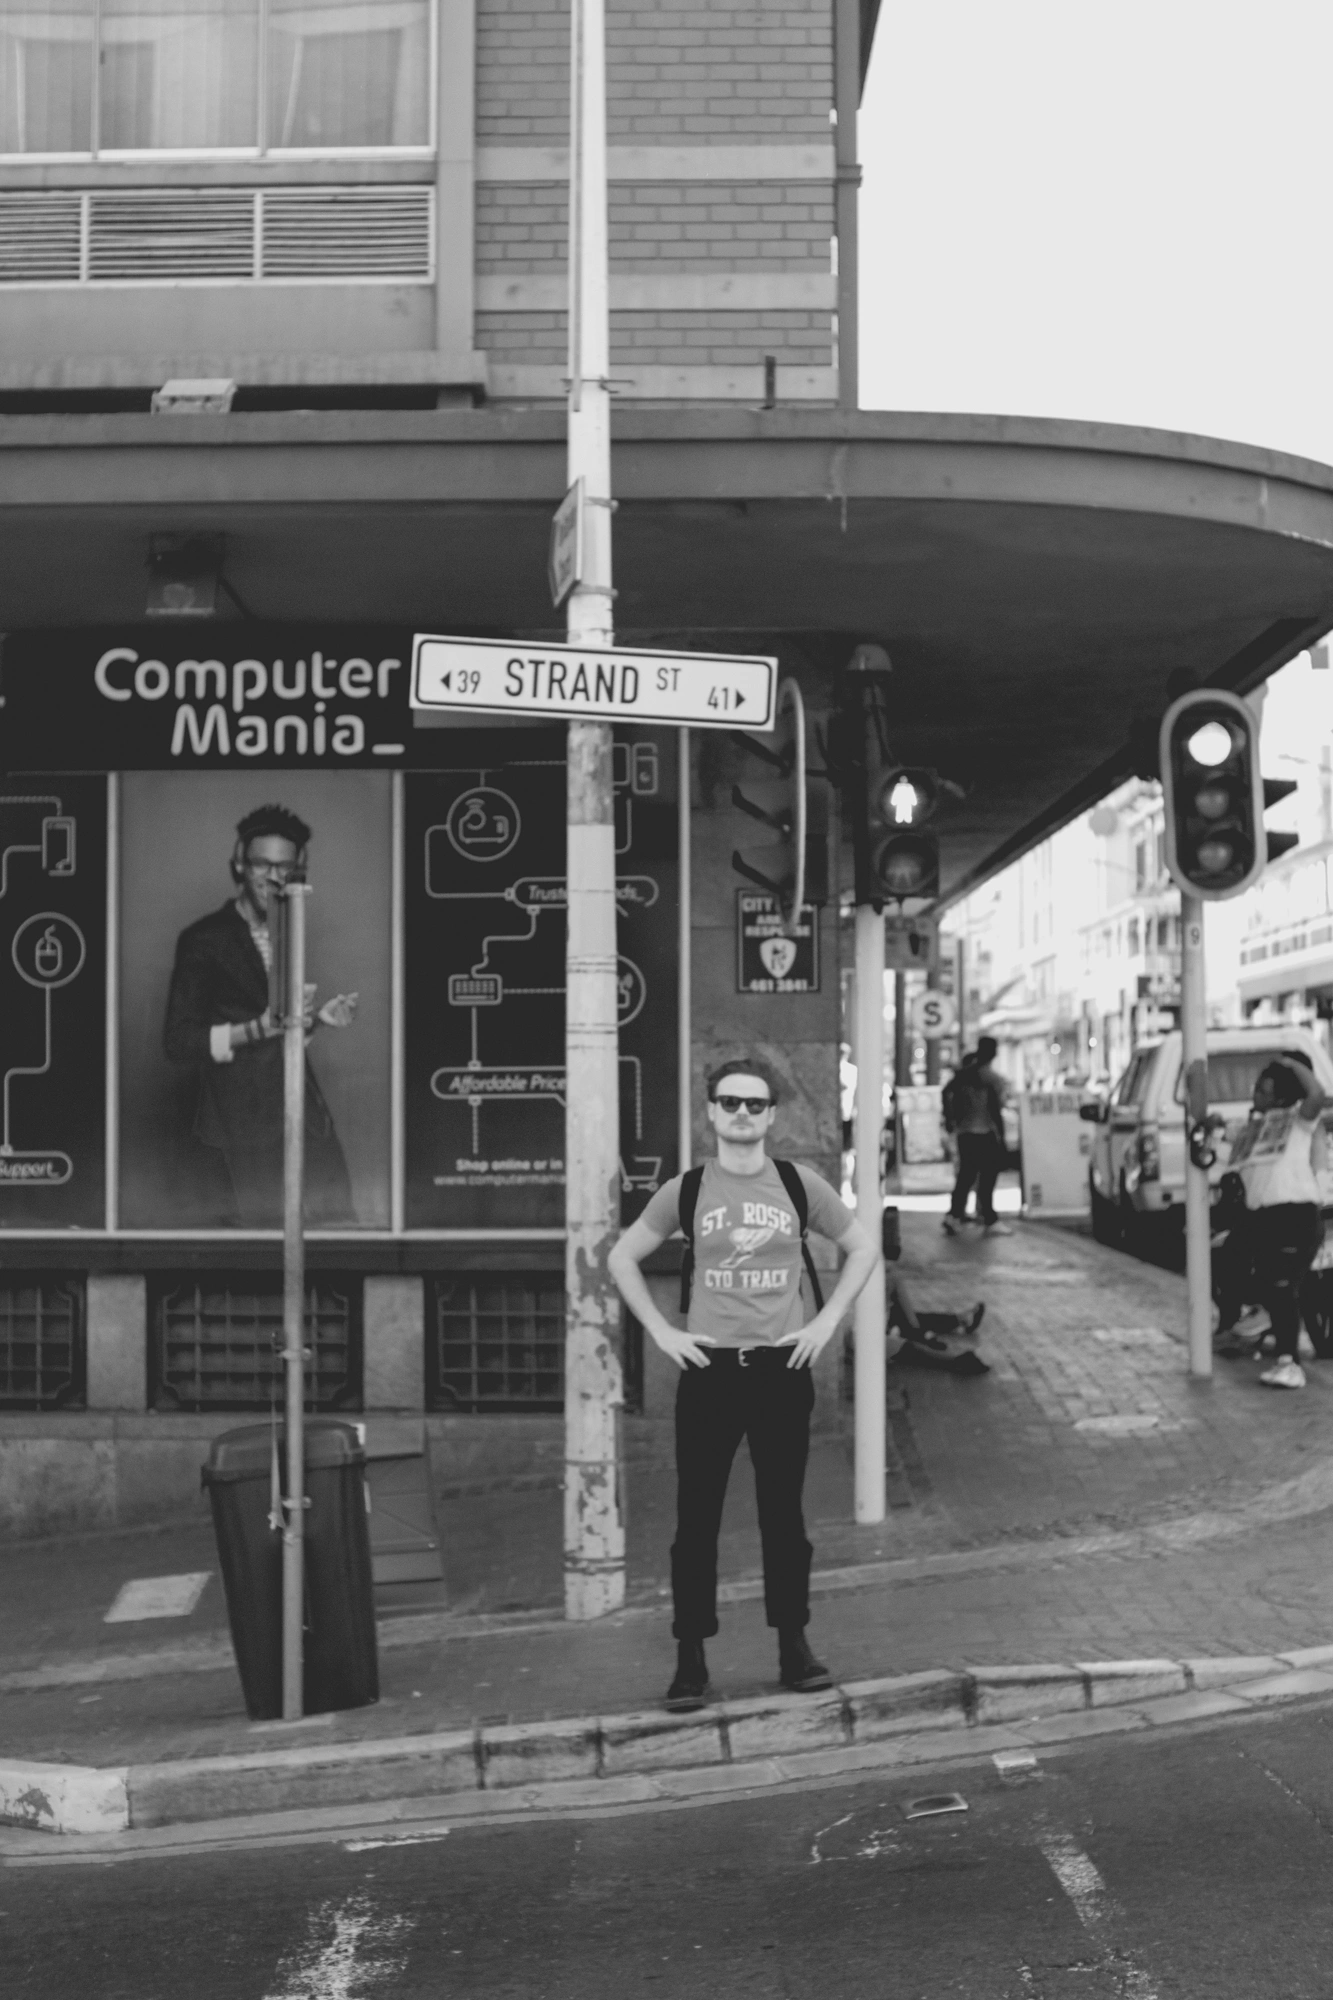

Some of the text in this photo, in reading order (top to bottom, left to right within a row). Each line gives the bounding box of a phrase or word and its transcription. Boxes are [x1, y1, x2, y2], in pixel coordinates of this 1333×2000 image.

[94, 647, 402, 713] Computer
[457, 658, 729, 711] 39 STRAND ST 41
[923, 1001, 942, 1027] S
[448, 1074, 528, 1094] Affordable
[701, 1202, 792, 1237] ST. ROSE
[739, 1268, 790, 1289] TRACK
